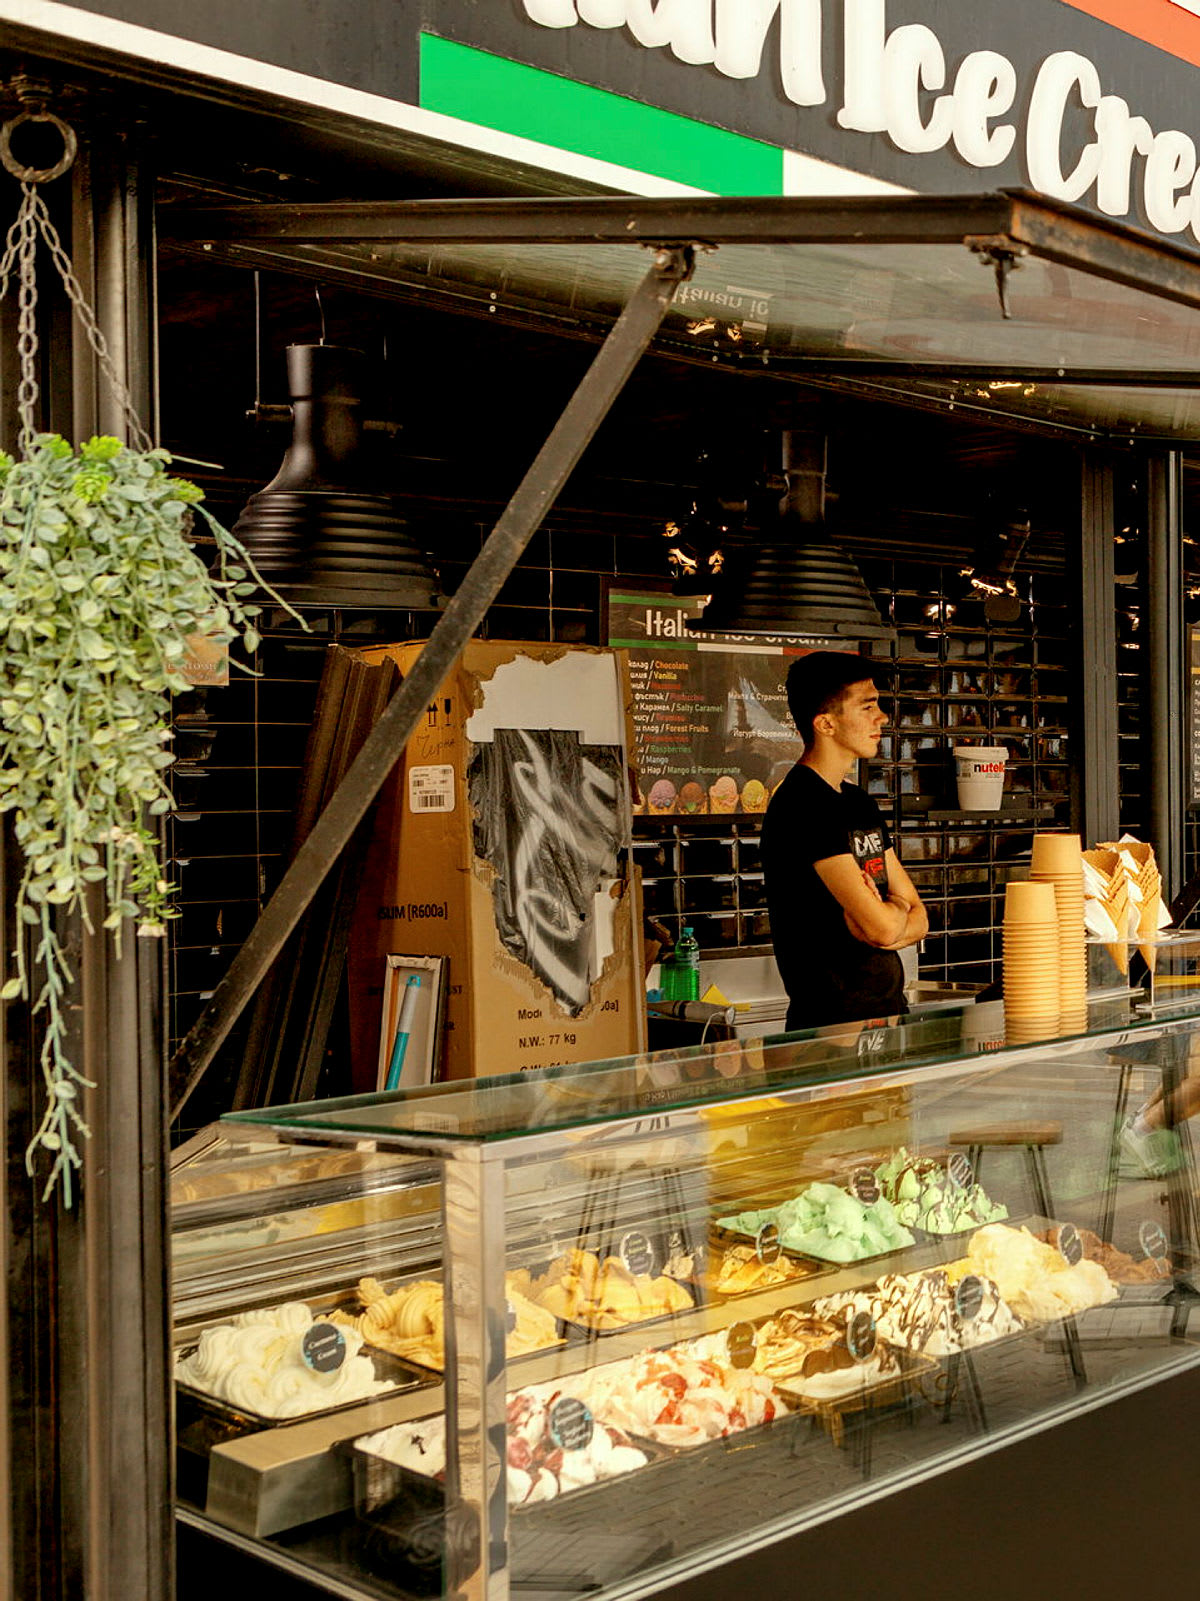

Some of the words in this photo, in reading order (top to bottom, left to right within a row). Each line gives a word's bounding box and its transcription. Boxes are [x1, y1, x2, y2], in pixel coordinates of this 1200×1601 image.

[838, 0, 1016, 167] Ice
[655, 661, 688, 670] Chocolate
[665, 725, 688, 733] Forest
[689, 724, 709, 733] Fruits
[646, 755, 669, 765] Mango
[667, 767, 690, 775] Mango
[548, 1034, 561, 1046] 77
[564, 1031, 577, 1045] kg
